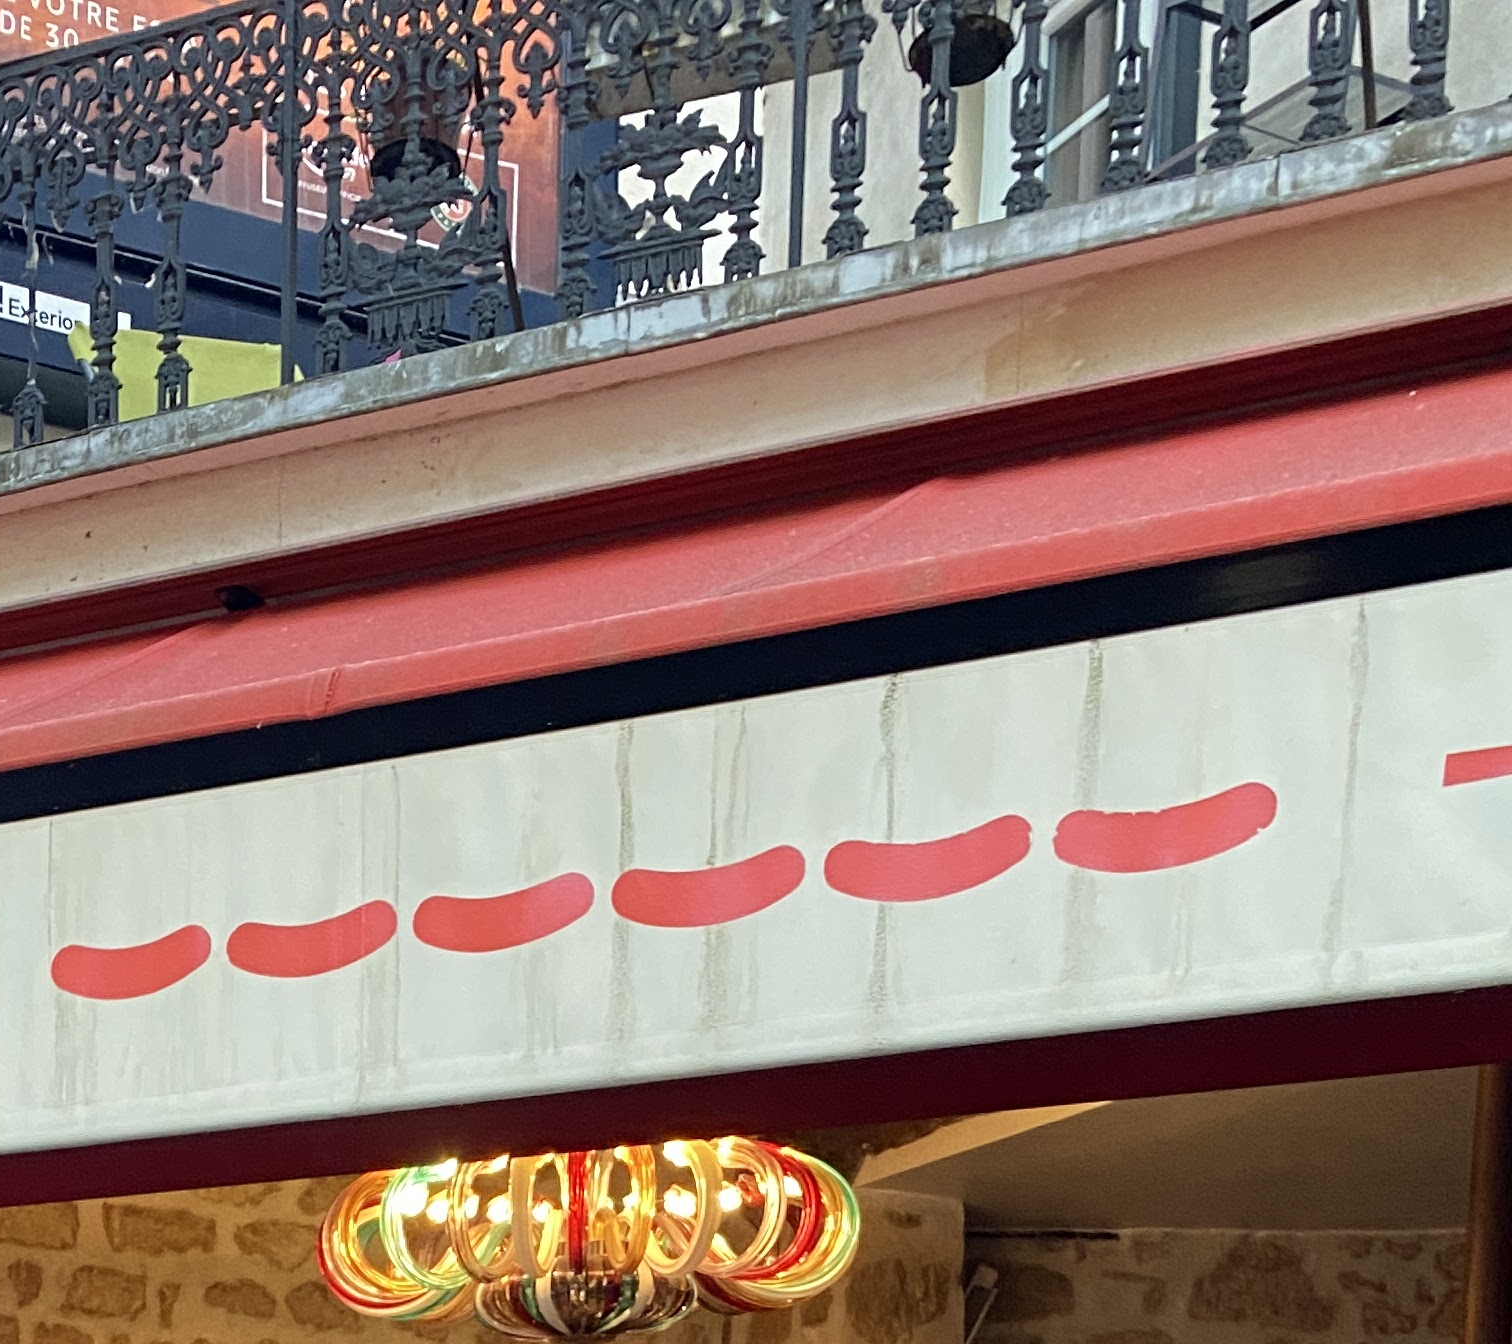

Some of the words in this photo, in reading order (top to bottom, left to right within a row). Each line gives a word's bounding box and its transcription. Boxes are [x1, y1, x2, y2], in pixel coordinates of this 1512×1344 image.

[0, 9, 32, 41] DE
[45, 22, 79, 48] 30
[9, 297, 81, 331] Exterio
